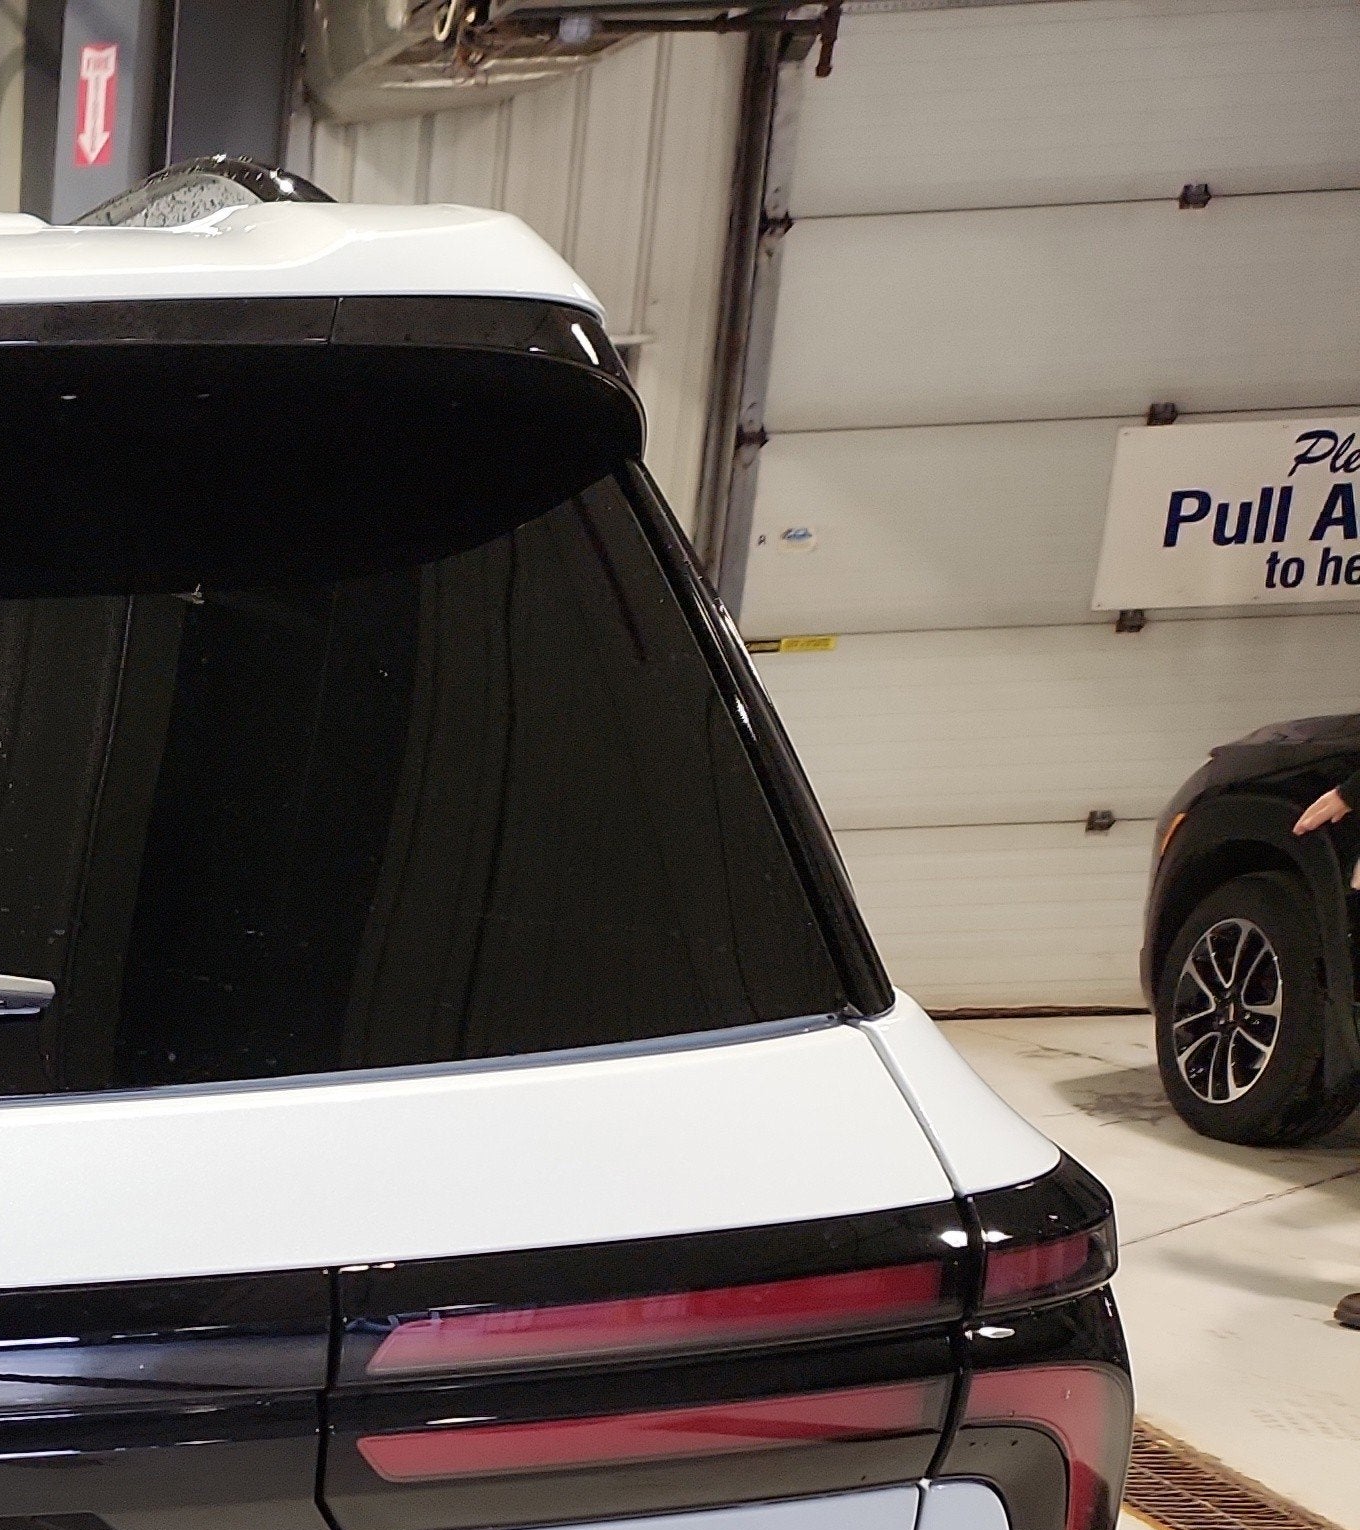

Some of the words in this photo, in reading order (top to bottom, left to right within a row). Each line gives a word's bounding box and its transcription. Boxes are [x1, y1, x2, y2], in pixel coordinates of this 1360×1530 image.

[1163, 485, 1294, 547] Pull
[1309, 482, 1358, 541] A
[1265, 551, 1305, 588] to
